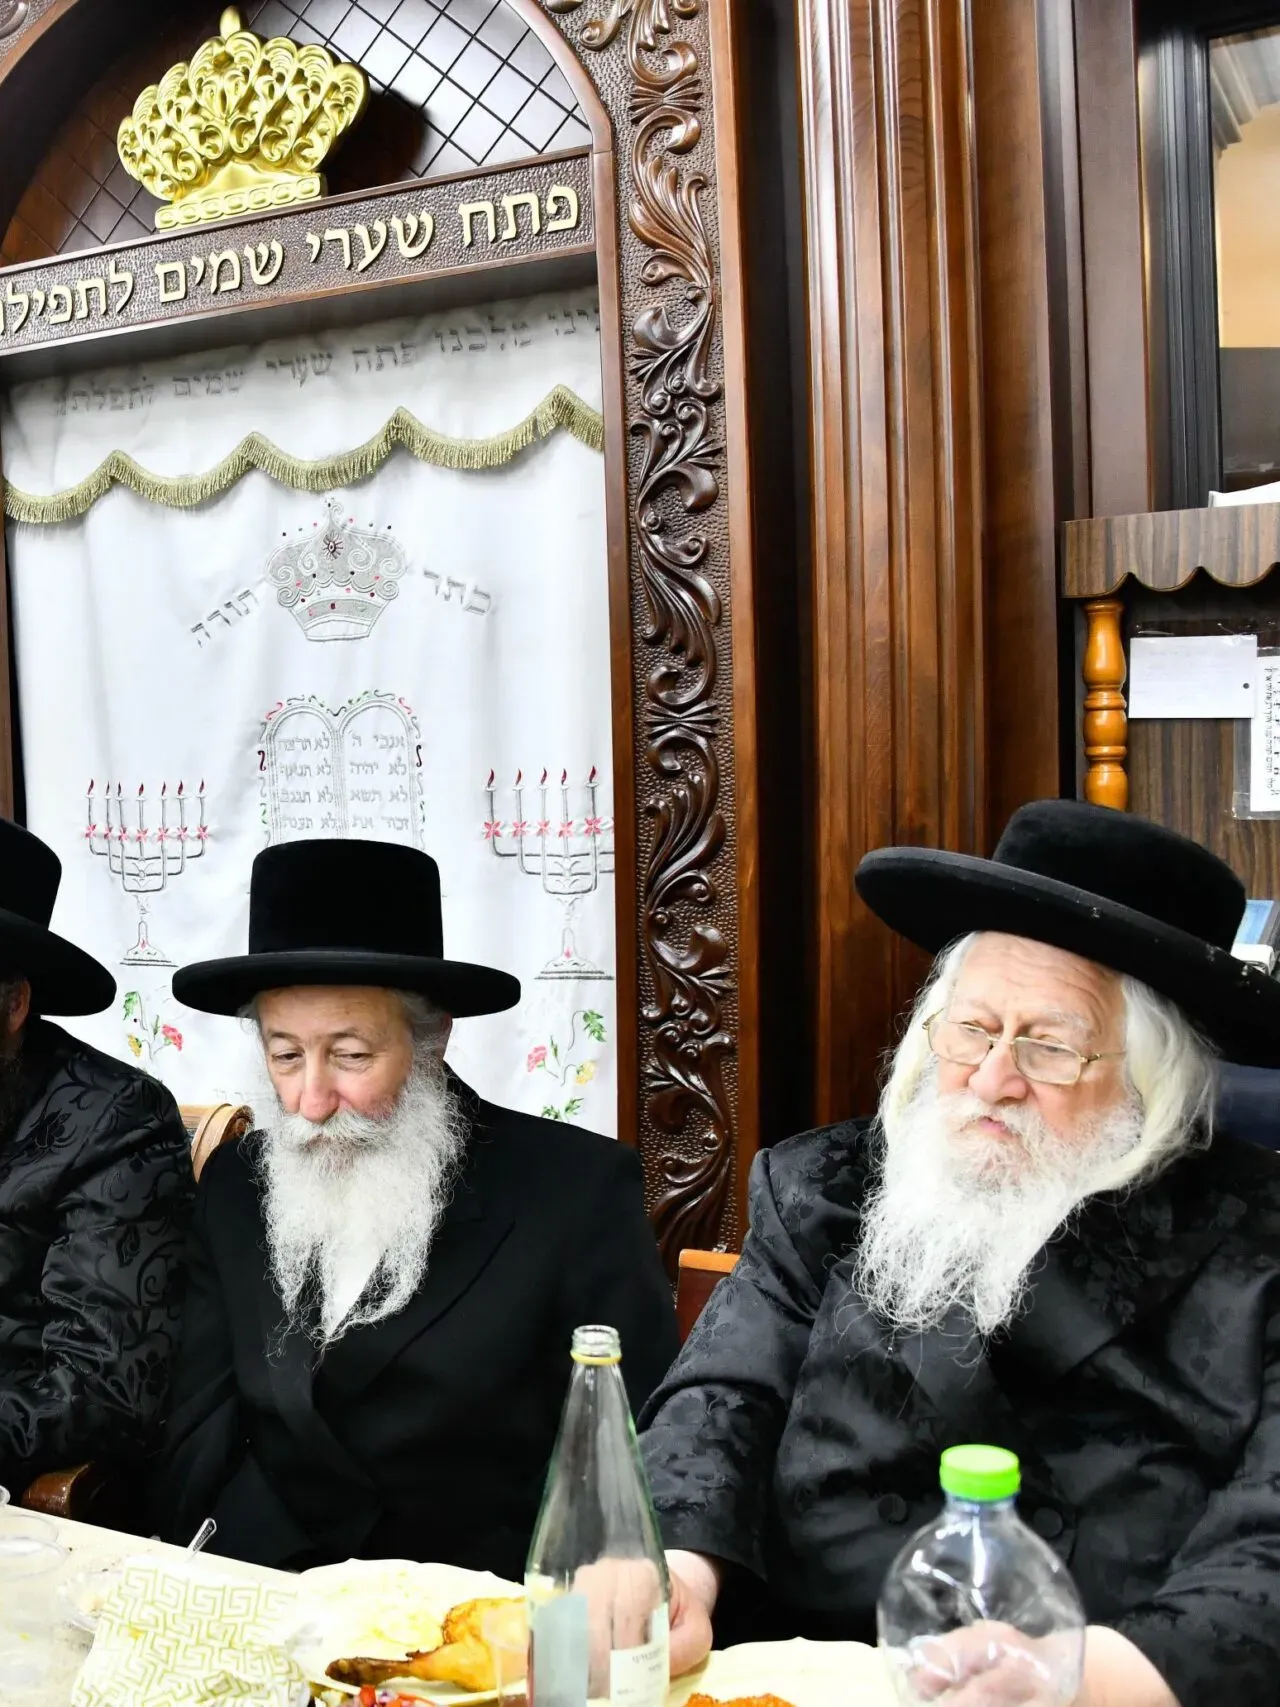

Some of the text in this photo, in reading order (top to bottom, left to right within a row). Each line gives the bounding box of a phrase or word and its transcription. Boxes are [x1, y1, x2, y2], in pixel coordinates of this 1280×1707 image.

[458, 182, 581, 246] פתח
[306, 211, 434, 273] שערי
[156, 239, 284, 304] שמים
[266, 350, 333, 388] שערי
[352, 342, 417, 373] פתח
[172, 369, 244, 397] שמים
[191, 568, 491, 648] כתר תורה
[314, 731, 330, 750] לא
[373, 733, 406, 750] אנכי
[316, 758, 331, 776] לא
[350, 756, 407, 776] לא יהיה
[317, 785, 333, 803] לא
[350, 785, 408, 803] לא תשא
[320, 812, 337, 829] לא
